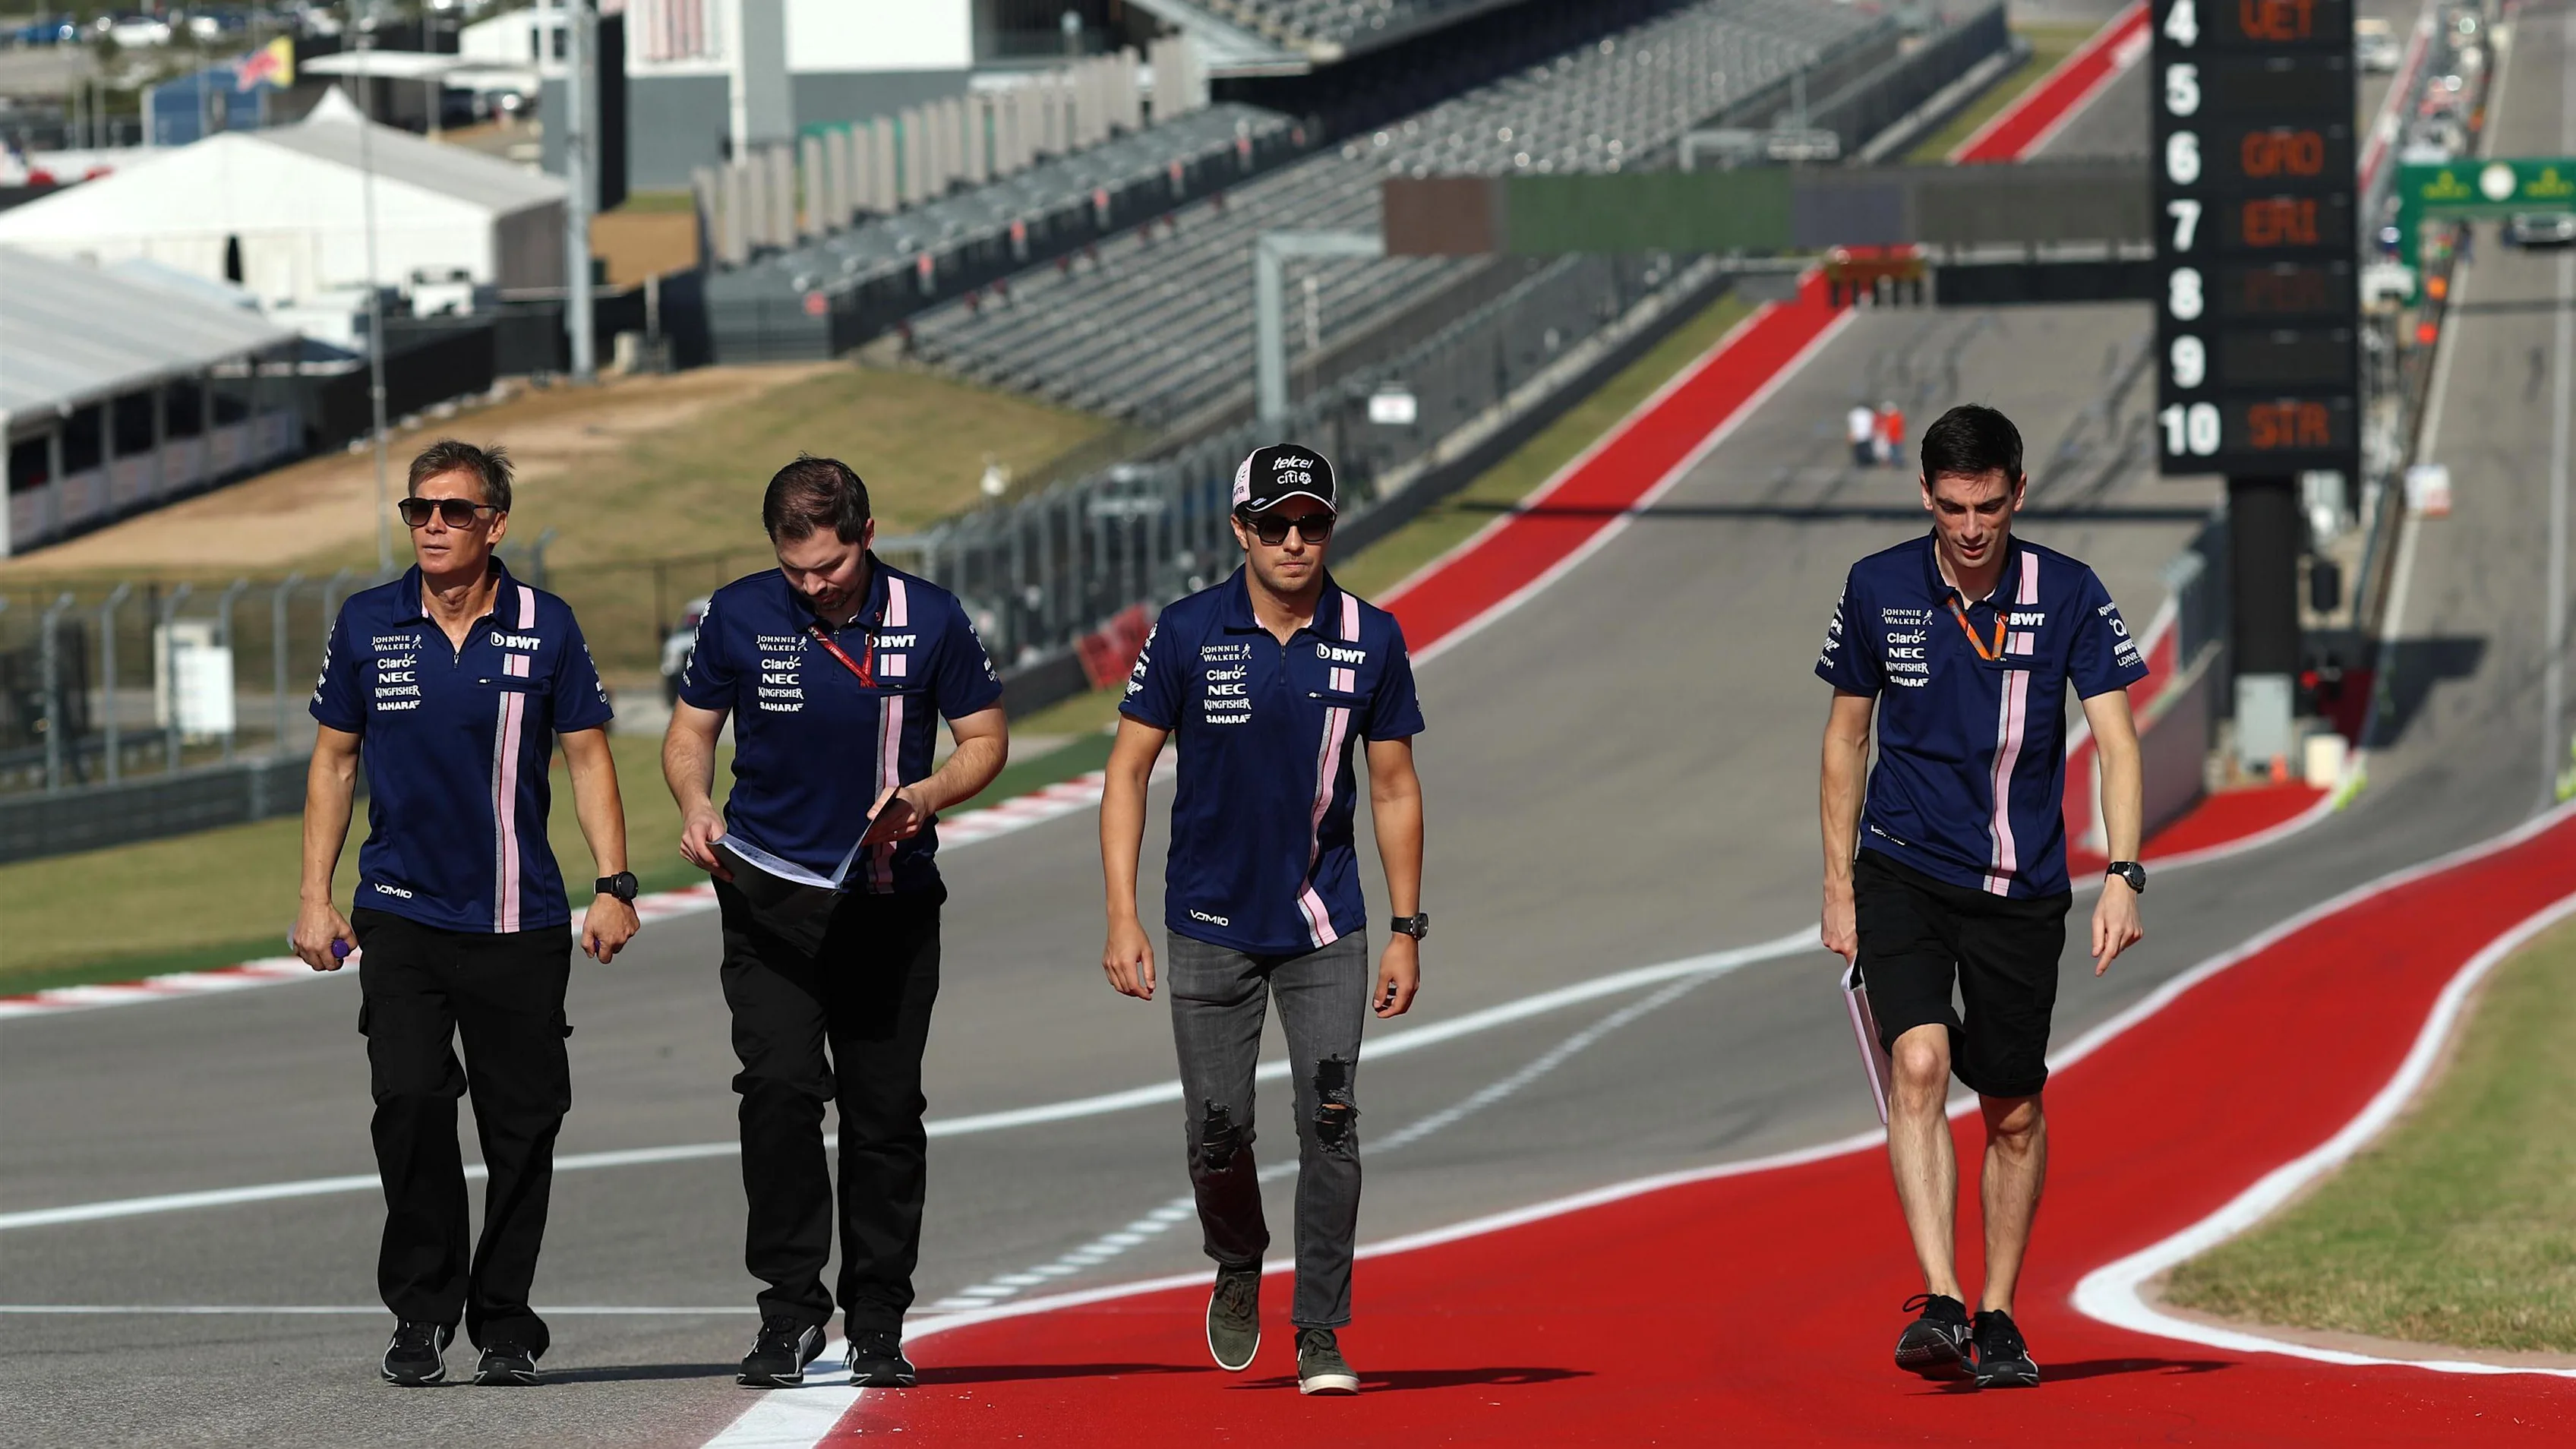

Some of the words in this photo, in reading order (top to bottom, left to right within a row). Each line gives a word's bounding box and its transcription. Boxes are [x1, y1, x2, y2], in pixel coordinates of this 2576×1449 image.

[2165, 0, 2198, 46] 4
[2167, 64, 2199, 115] 5
[2167, 131, 2200, 184] 6
[2168, 200, 2200, 251] 7
[2170, 268, 2202, 320] 8
[2171, 336, 2204, 387] 9
[2160, 402, 2220, 455] 10
[2250, 403, 2329, 447] STR
[1273, 456, 1313, 470] telcel
[1277, 470, 1297, 484] citi
[1882, 608, 1921, 617] JOHNNIE
[1884, 616, 1920, 625] WALKER
[2009, 613, 2044, 626] BWT
[371, 636, 409, 645] JOHNNIE
[756, 635, 796, 645] JOHNNIE
[881, 635, 916, 647] BWT
[1887, 629, 1919, 643] Claro
[374, 643, 409, 652] WALKER
[507, 636, 540, 650] BWT
[1201, 645, 1239, 655] JOHNNIE
[1331, 648, 1365, 664] BWT
[1889, 648, 1924, 658] NEC
[377, 653, 409, 669] Claro
[762, 655, 794, 669] Claro
[1203, 653, 1239, 661] WALKER
[1207, 665, 1240, 680] Claro
[1886, 661, 1929, 674] KINGFISHER
[379, 671, 415, 683] NEC
[762, 674, 799, 684] NEC
[375, 685, 421, 698] KINGFISHER
[759, 687, 803, 699] KINGFISHER
[1208, 683, 1246, 695] NEC
[377, 700, 416, 710] SAHARA
[760, 702, 798, 712] SAHARA
[1204, 698, 1252, 711] KINGFISHER
[1206, 715, 1245, 724] SAHARA
